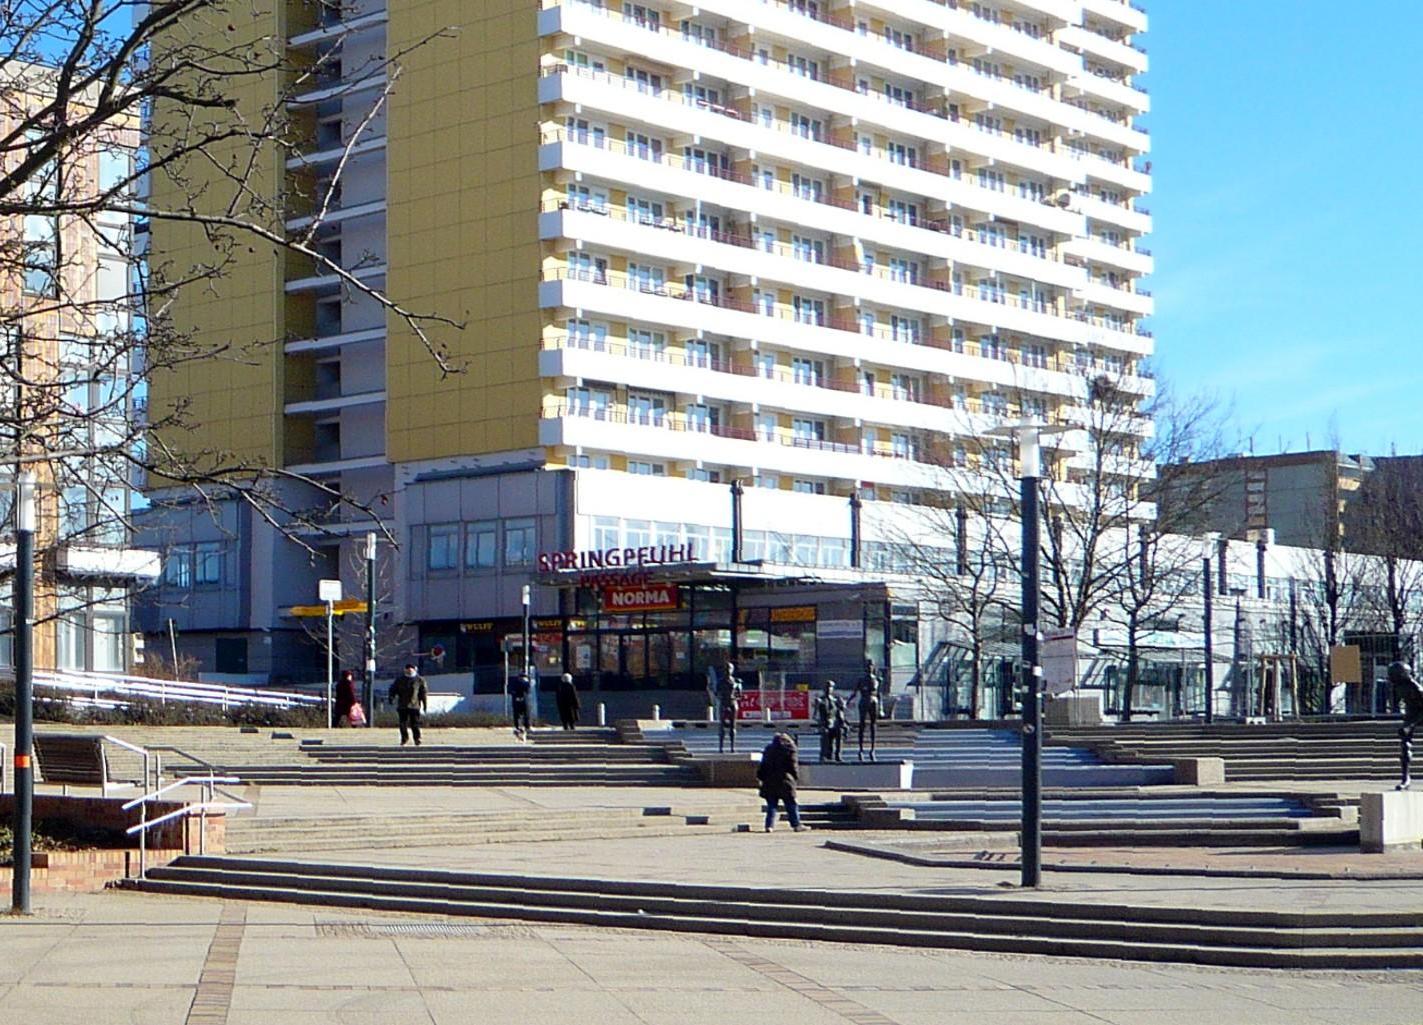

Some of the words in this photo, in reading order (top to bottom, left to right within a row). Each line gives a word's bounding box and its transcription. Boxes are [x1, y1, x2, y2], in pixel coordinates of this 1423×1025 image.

[538, 543, 699, 572] SPRINGPFUHL
[579, 571, 653, 588] PASSAGE
[612, 590, 670, 606] NORMA
